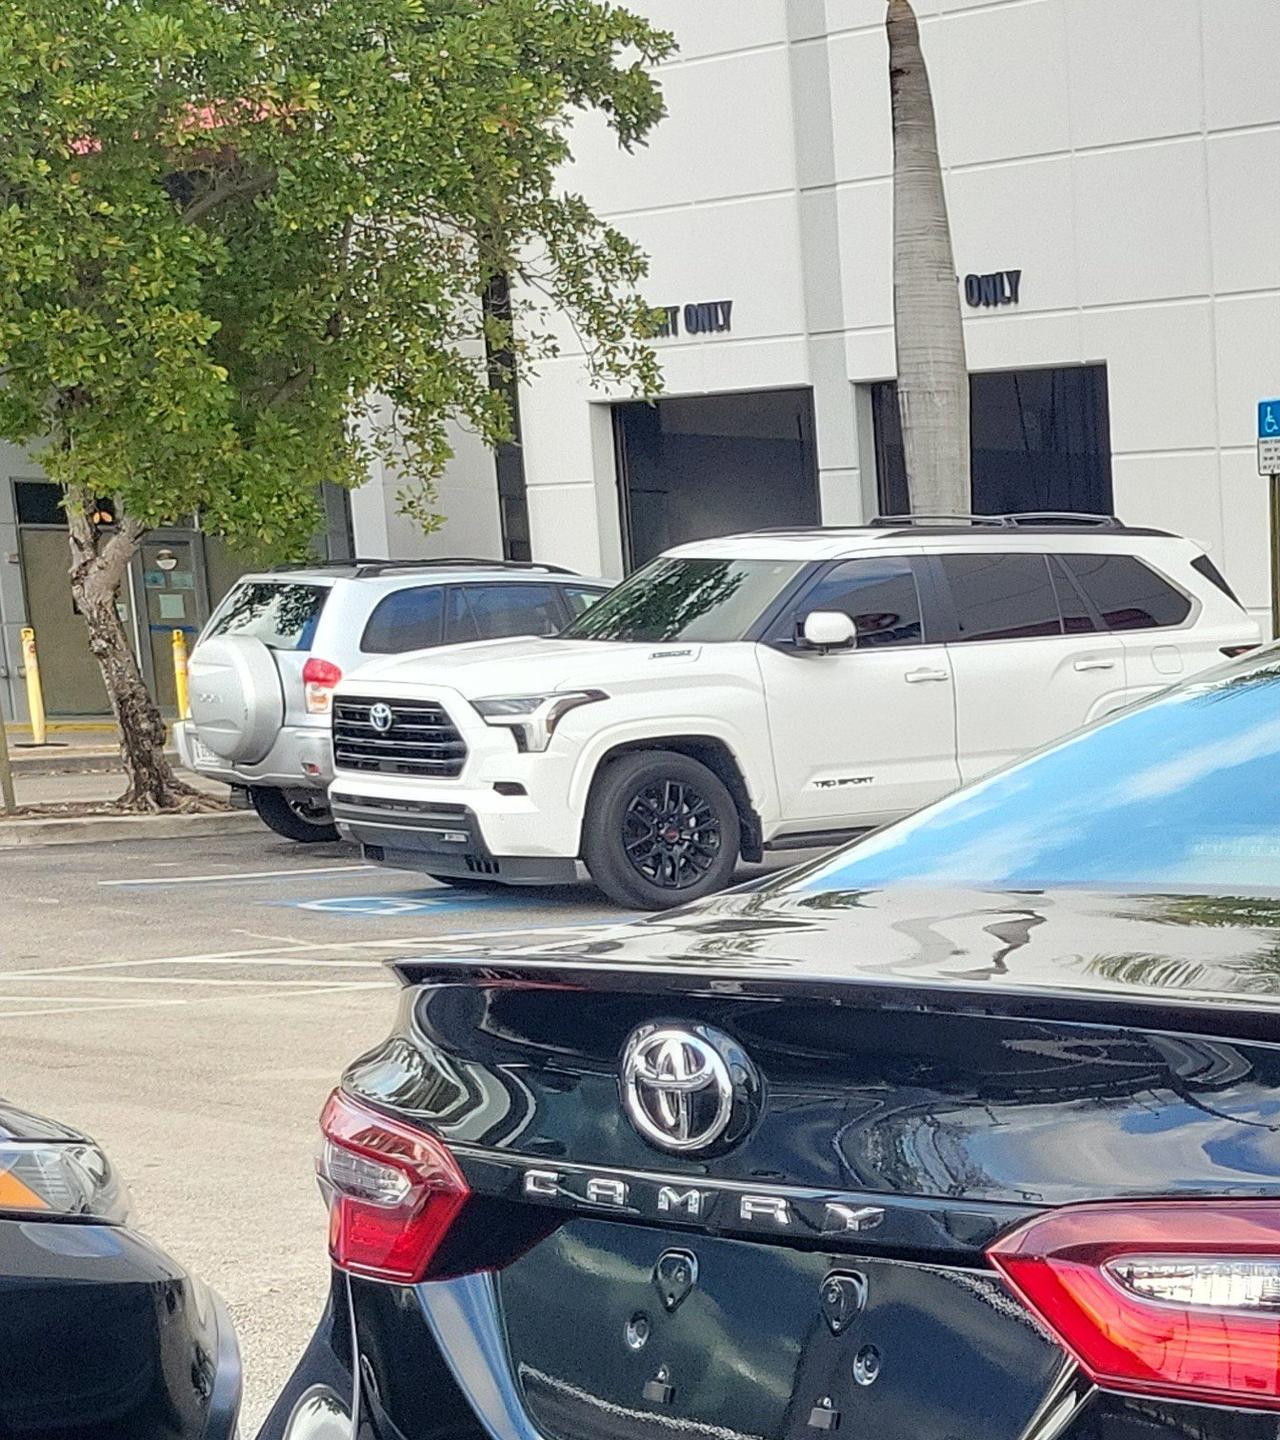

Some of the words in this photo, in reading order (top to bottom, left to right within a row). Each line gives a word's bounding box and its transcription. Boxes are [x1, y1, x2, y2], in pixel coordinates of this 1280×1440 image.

[965, 270, 1021, 308] ONLY
[684, 301, 732, 334] ONLY
[813, 780, 836, 788] TRD
[838, 777, 874, 785] SPORT
[524, 1169, 885, 1235] CAMRY
